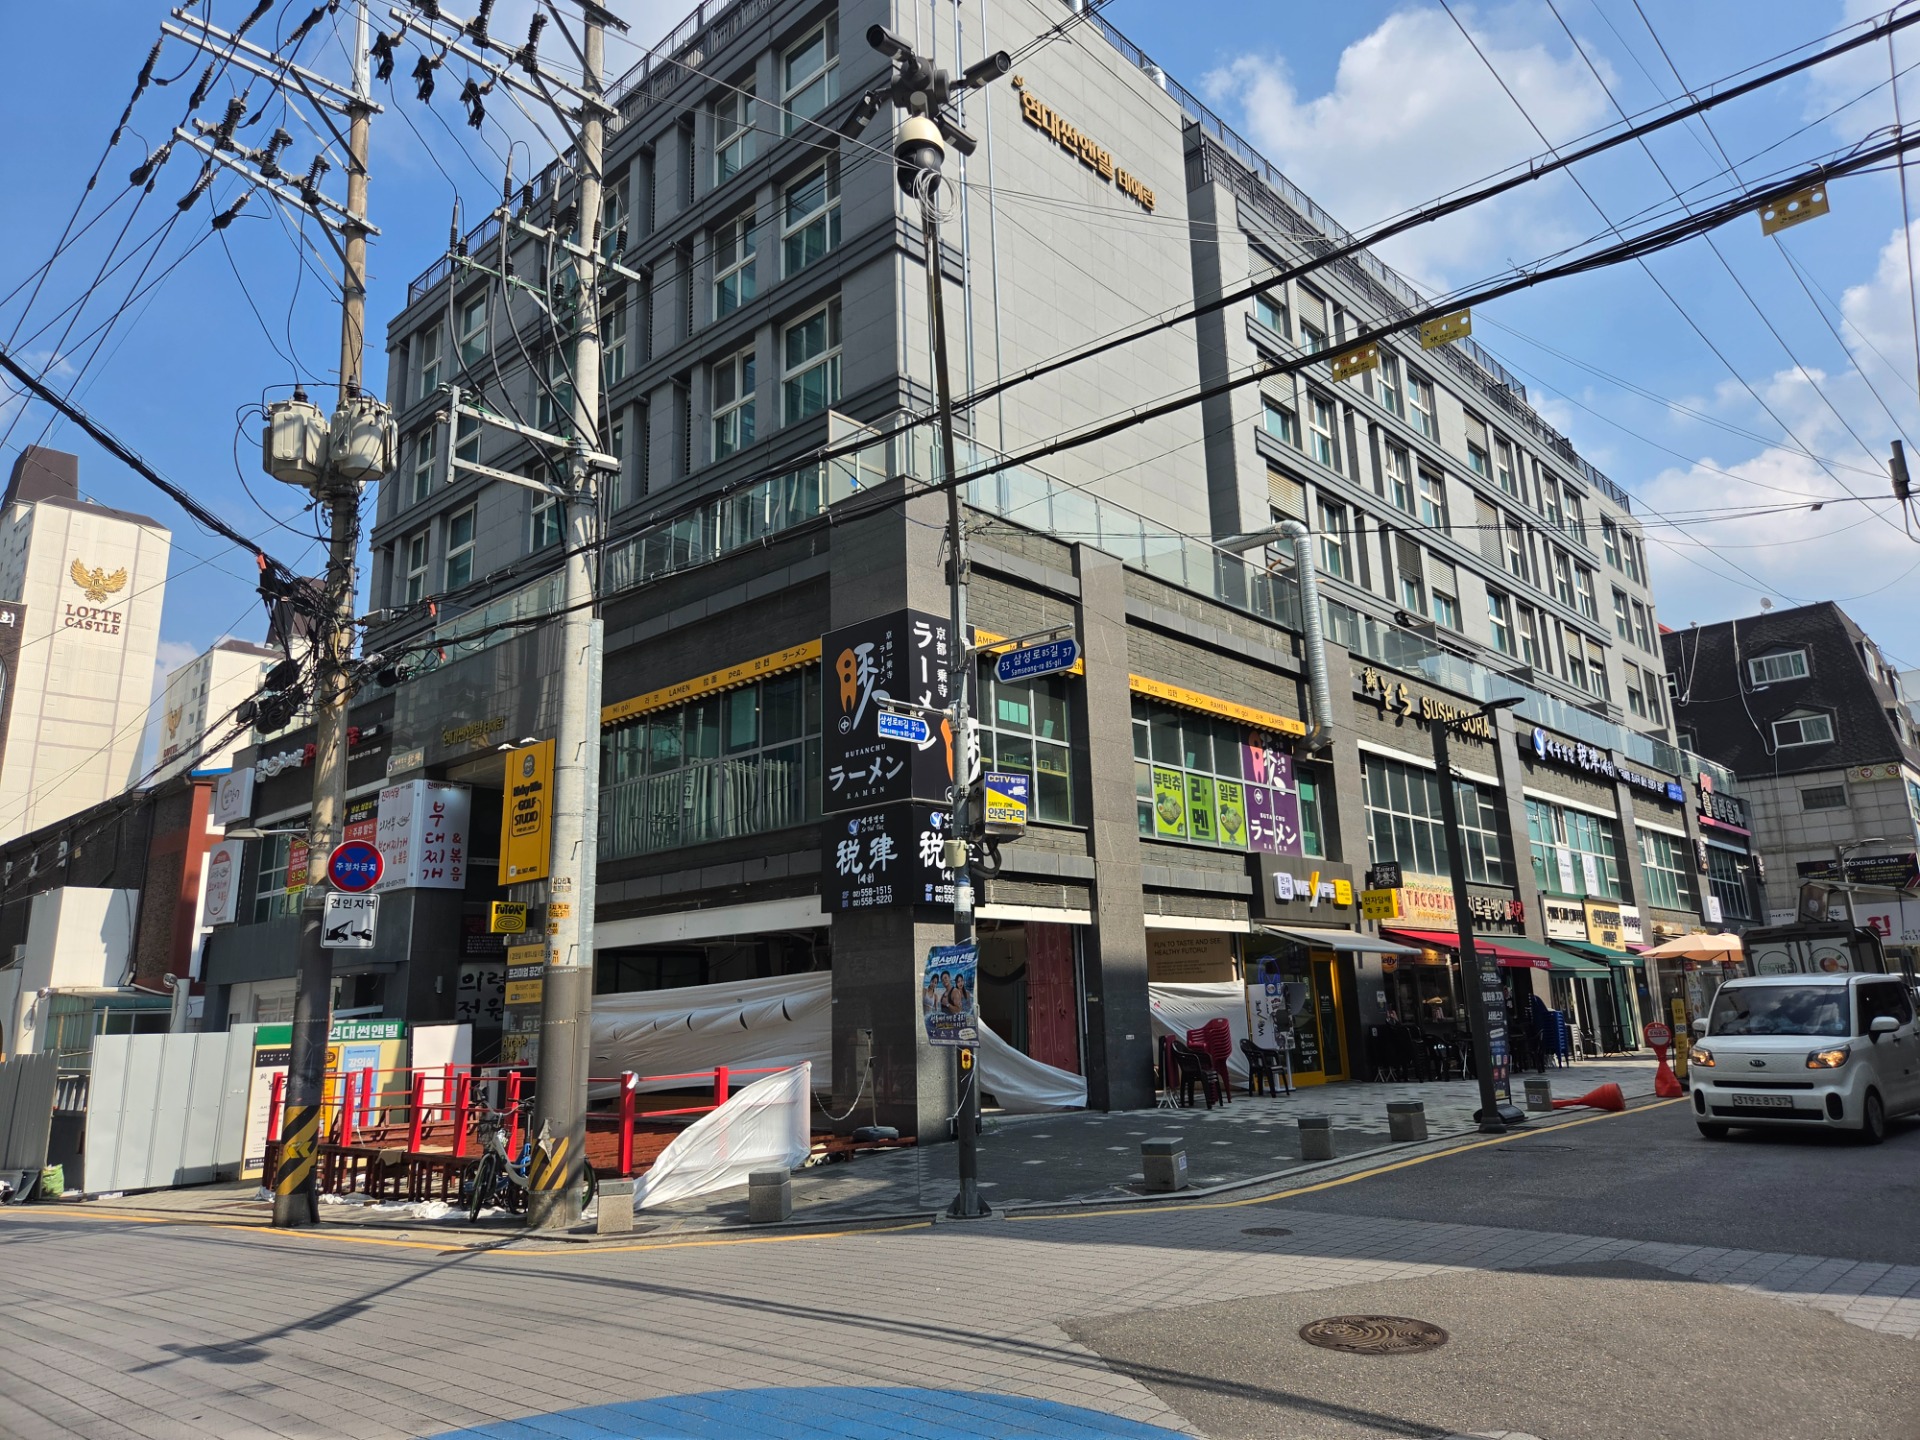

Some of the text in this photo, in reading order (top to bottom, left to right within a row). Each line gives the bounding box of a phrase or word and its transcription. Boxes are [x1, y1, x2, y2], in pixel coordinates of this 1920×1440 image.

[1022, 91, 1156, 211] 현대썬앤빌 테헤란
[66, 603, 122, 624] LOTTE
[64, 616, 120, 635] CASTLE
[1001, 643, 1073, 672] 33 삼성로85길 37
[1010, 660, 1046, 677] Samseong-ro
[668, 684, 691, 698] LAMEN
[1421, 696, 1458, 727] SUSHI
[844, 743, 887, 758] BUTANCHU
[828, 755, 904, 792] ラーメン
[1153, 771, 1182, 791] 부탄츄
[846, 784, 887, 800] RAMEN
[1218, 783, 1239, 803] 일본
[517, 797, 537, 811] GOLF
[1190, 778, 1210, 837] 라멘
[514, 811, 539, 827] STUDIO
[987, 807, 1026, 822] 안전구역
[1259, 812, 1286, 823] BUTACHU
[423, 801, 445, 880] 부대찌개
[1250, 819, 1297, 845] ラーメン
[335, 862, 377, 872] 주정차금지
[450, 847, 463, 882] 볶음
[1847, 860, 1877, 868] OXING
[1877, 857, 1899, 865] GYM
[330, 897, 376, 910] 견인지역
[1363, 895, 1391, 905] 전자담배
